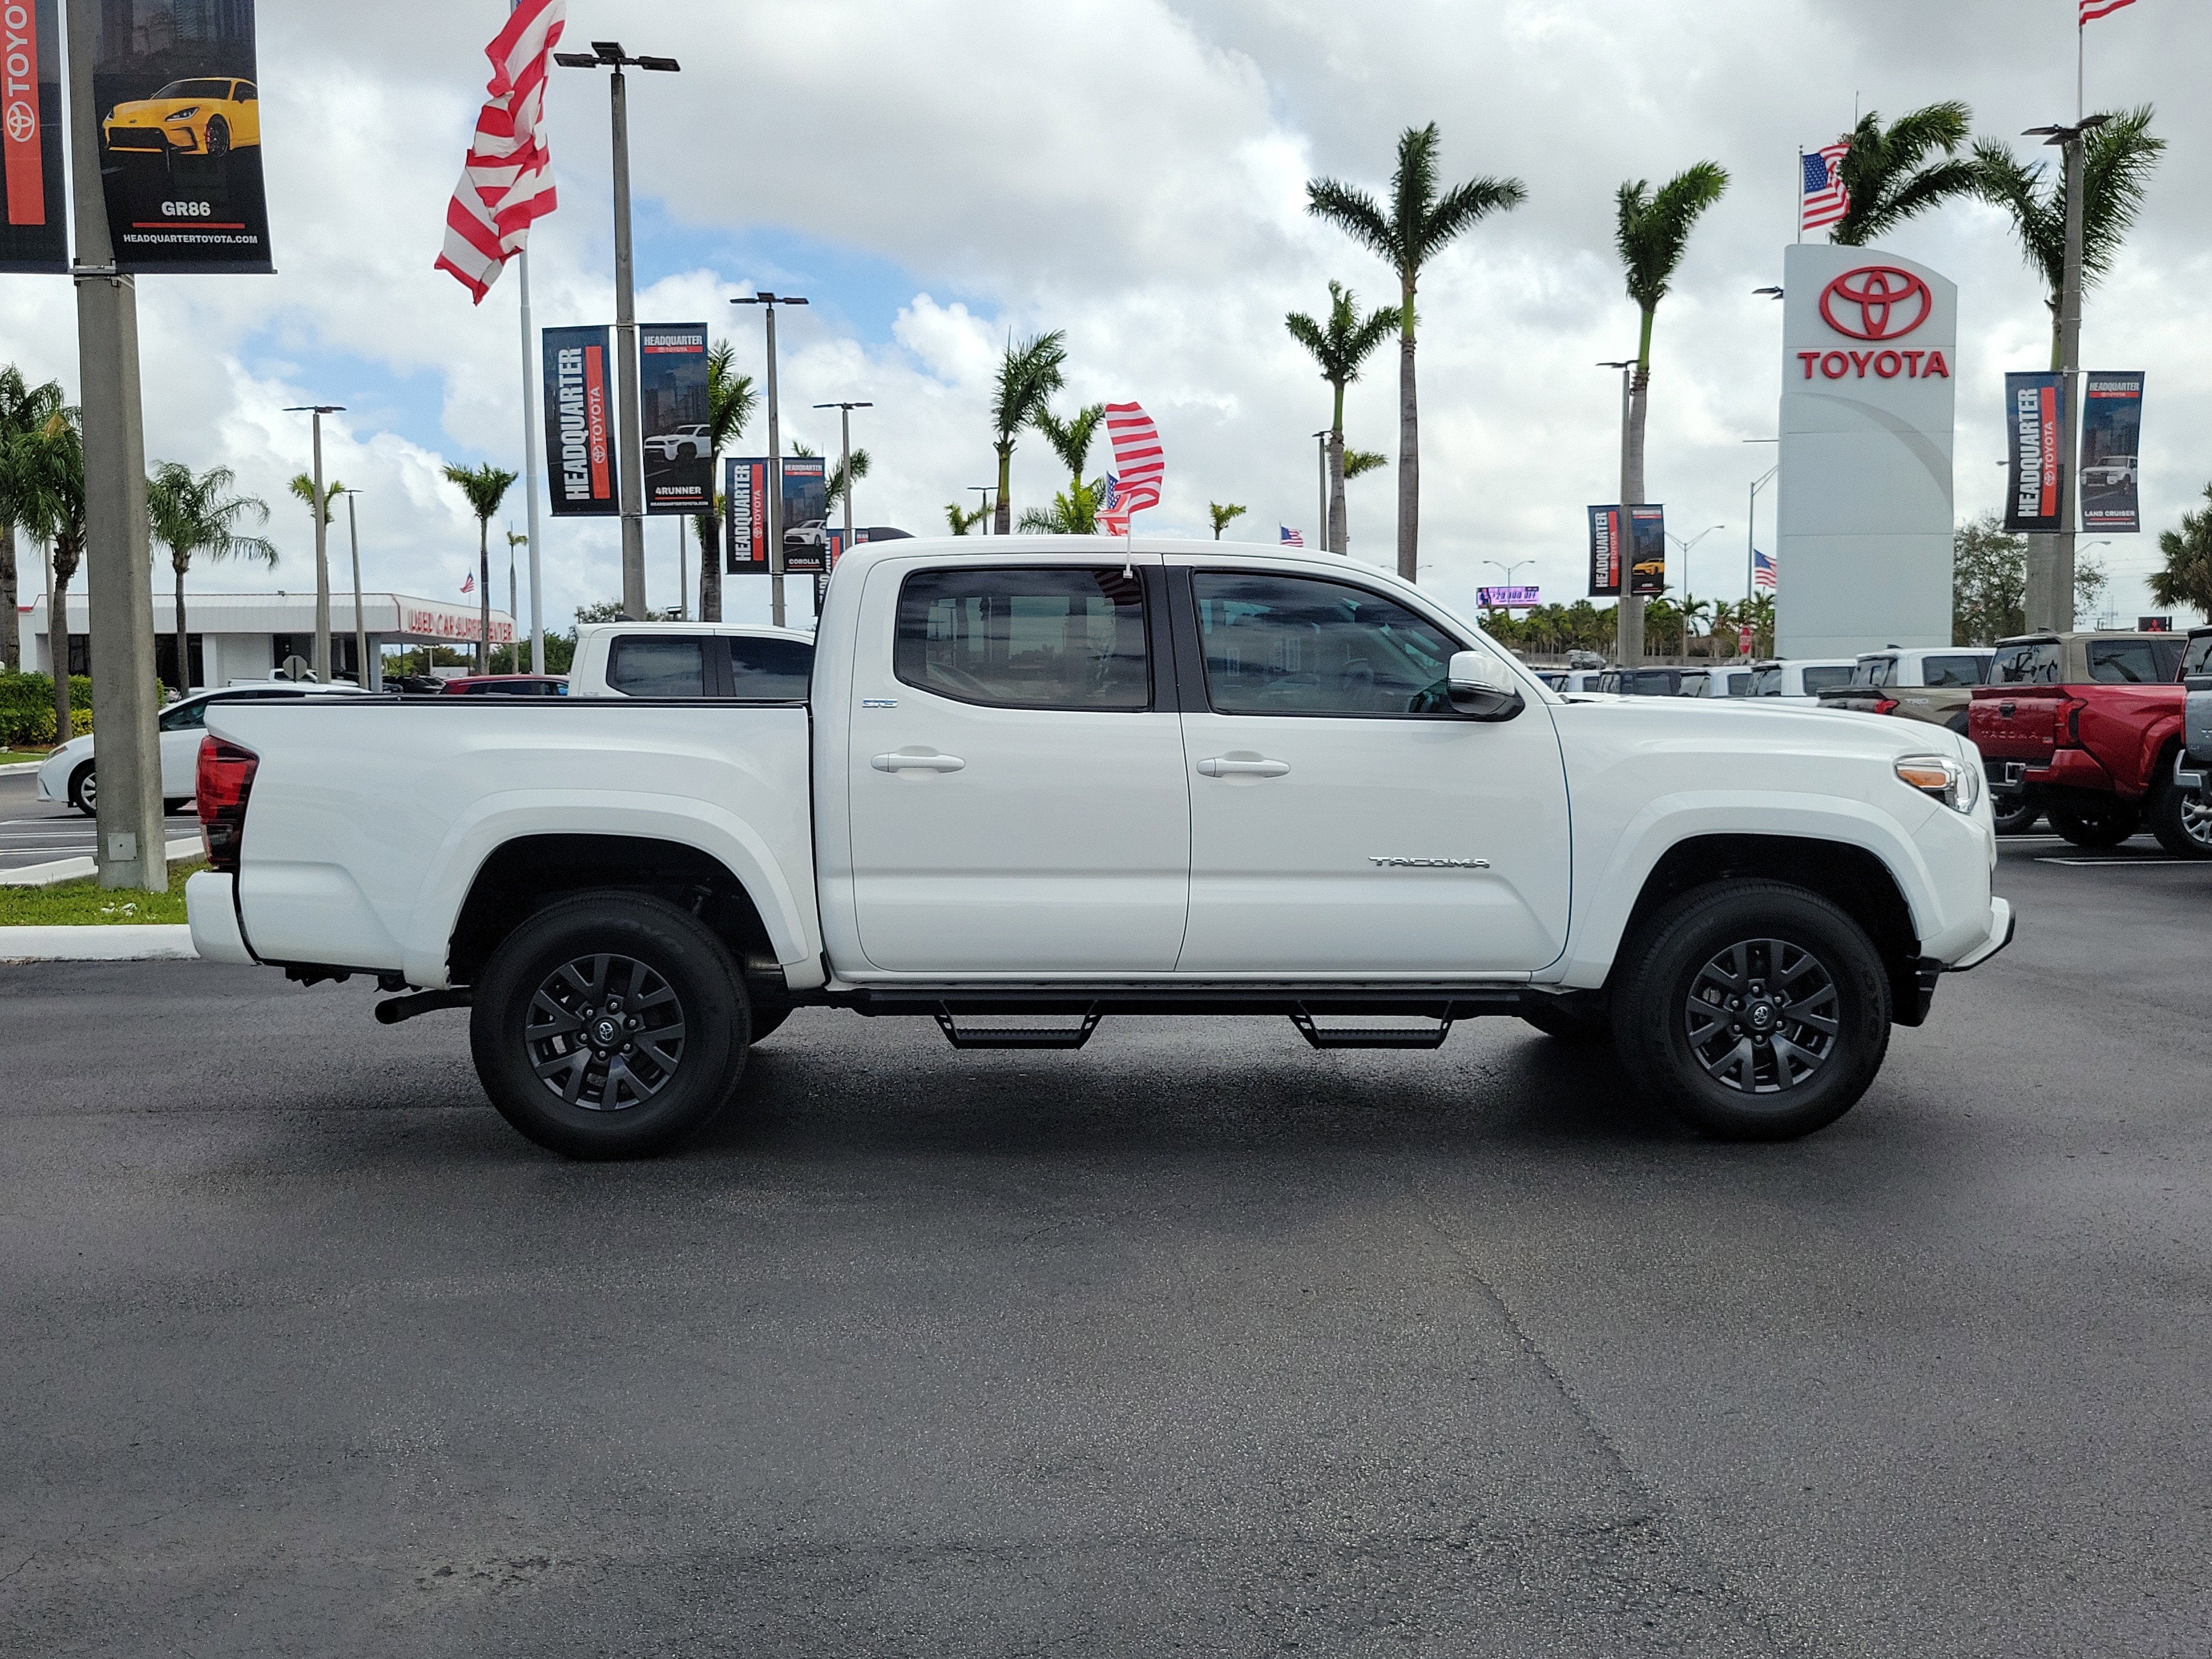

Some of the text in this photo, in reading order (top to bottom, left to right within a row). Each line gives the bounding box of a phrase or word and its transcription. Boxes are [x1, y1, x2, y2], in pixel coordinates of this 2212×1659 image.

[5, 0, 30, 97] TOYO
[161, 201, 211, 217] GR86
[123, 234, 258, 244] HEADQUARTERTOYOTA.COM
[644, 335, 703, 346] HEADQUARTER
[1797, 350, 1949, 379] TOYOTA
[558, 347, 590, 500] HEADQUARTER
[590, 386, 603, 444] TOYOTA
[2017, 388, 2042, 517] HEADQUARTER
[2042, 421, 2055, 472] TOYOTA
[655, 486, 702, 495] 4RUNNER
[734, 464, 753, 561] HEADQUARTER
[1594, 512, 1610, 588] HEADQUARTER
[1610, 531, 1619, 561] TOYOTA
[409, 610, 434, 633] USED
[436, 613, 455, 635] CAR
[1368, 856, 1491, 868] TACOMA
